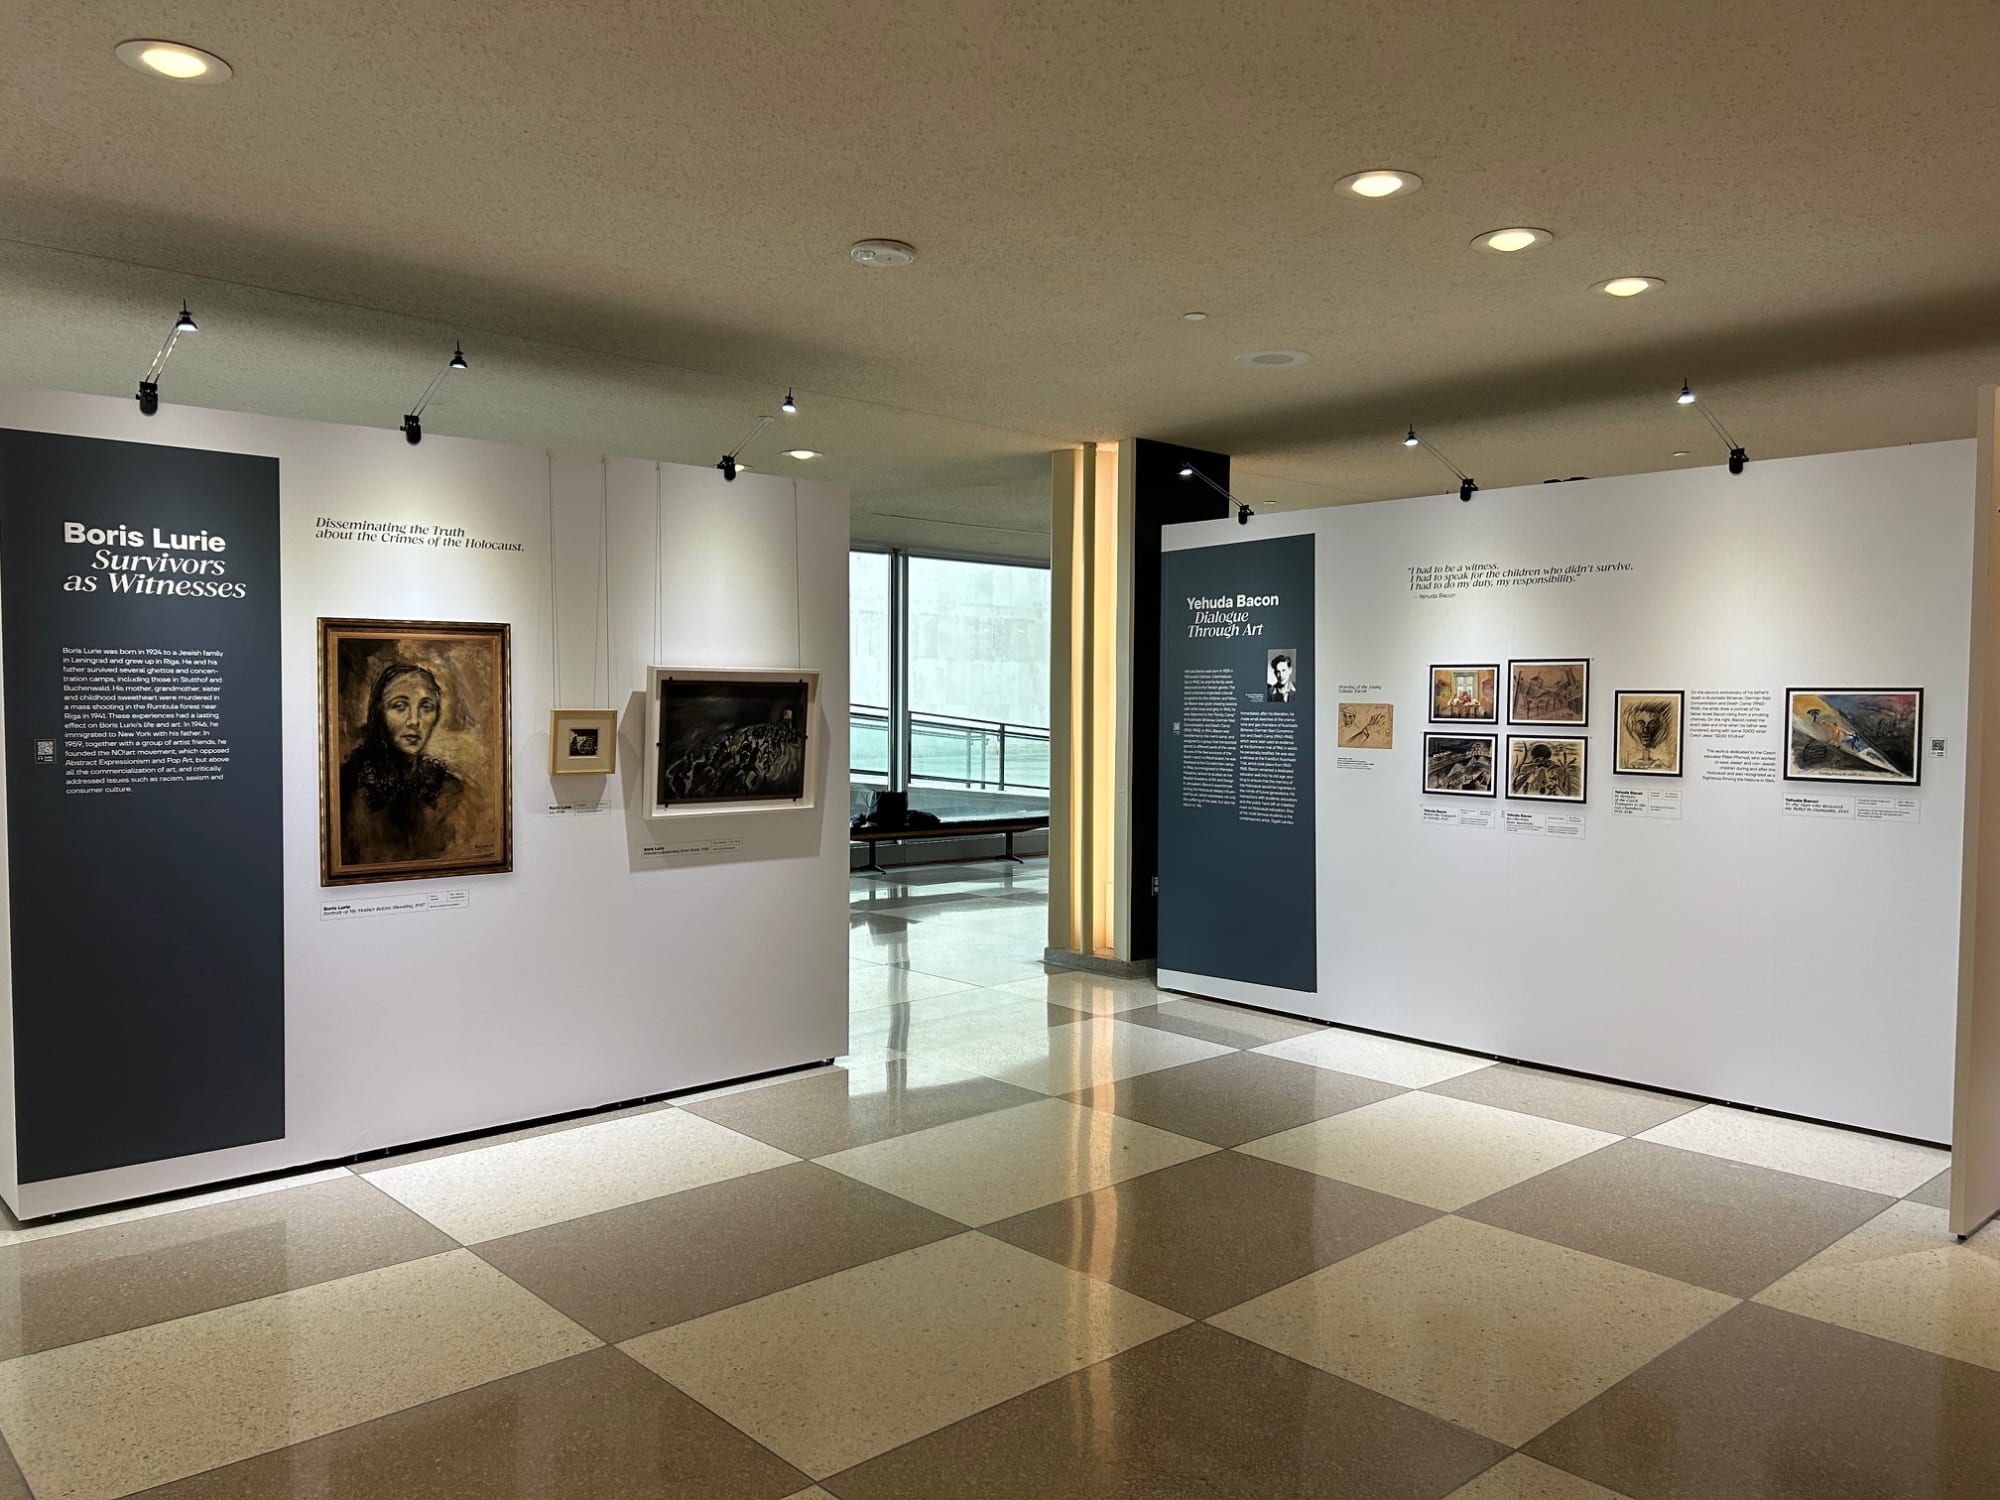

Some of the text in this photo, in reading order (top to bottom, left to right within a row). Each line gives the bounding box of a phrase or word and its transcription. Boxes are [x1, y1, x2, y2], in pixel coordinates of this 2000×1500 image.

[316, 517, 465, 537] Disseminating the Truth
[64, 522, 226, 552] Boris Lurie
[315, 529, 525, 552] about the Crimes of the Holocaust.
[91, 549, 226, 575] Survivors
[1410, 574, 1415, 582] I
[1416, 574, 1432, 582] had
[1444, 572, 1469, 584] speak
[1470, 570, 1483, 581] for
[1485, 569, 1500, 579] the
[1502, 567, 1540, 578] children
[1543, 566, 1563, 575] who
[1565, 563, 1593, 574] didn't
[1416, 566, 1432, 574] had
[1444, 564, 1456, 572] be
[64, 573, 246, 599] as Witnesses
[1410, 582, 1415, 591] I
[1416, 582, 1432, 590] had
[1444, 579, 1455, 589] do
[1457, 580, 1470, 589] my
[1496, 578, 1511, 587] my
[1187, 594, 1279, 610] Yehuda Bacon
[1195, 611, 1248, 624] Dialogue
[1188, 624, 1264, 639] Through Art
[202, 650, 223, 659] family
[70, 657, 108, 666] Leningrad
[124, 658, 143, 667] grew
[146, 667, 174, 676] ghettos
[116, 676, 149, 685] including
[91, 703, 124, 712] shooting
[64, 712, 81, 721] Riga
[131, 712, 174, 721] experiences
[195, 712, 219, 721] lasting
[64, 731, 107, 740] immigrated
[85, 740, 117, 749] together
[141, 740, 163, 748] group
[199, 747, 229, 756] opposed
[98, 758, 150, 767] Expressionism
[166, 757, 180, 766] Pop
[192, 766, 222, 775] critically
